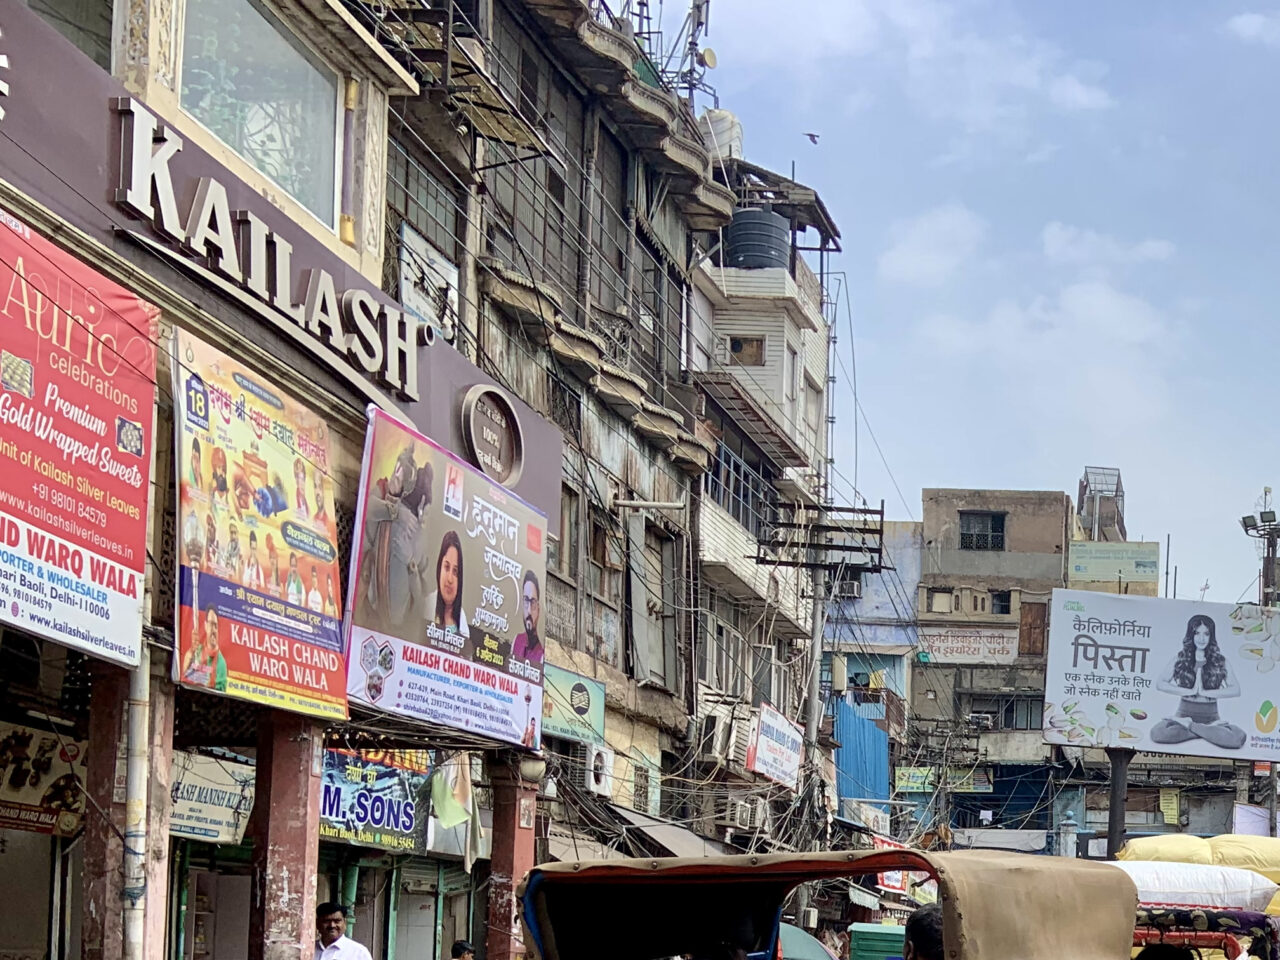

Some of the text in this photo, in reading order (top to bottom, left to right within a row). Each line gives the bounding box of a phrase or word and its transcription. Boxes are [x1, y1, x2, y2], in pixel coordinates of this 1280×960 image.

[115, 97, 420, 402] KAILASH
[1, 256, 122, 377] Auric
[49, 351, 139, 414] celebrations
[188, 389, 206, 417] 18
[44, 381, 108, 437] Premium
[0, 392, 144, 488] Gold Wrapped Sweets
[20, 450, 32, 468] of
[33, 455, 74, 489] Kailash
[76, 476, 105, 503] Silver
[106, 491, 140, 521] Leaves
[32, 482, 107, 528] +91 98101 84579
[0, 490, 134, 561] www.kailashsilverleaves.in
[465, 494, 521, 555] हनुमान
[0, 549, 109, 605] ORTER & WHOLESALER
[26, 527, 138, 600] WARQ WALA
[483, 541, 523, 581] जन्मोत्सव
[13, 587, 53, 612] 9810184579
[19, 573, 47, 598] Baoli,
[50, 586, 111, 621] Delhi-110006
[480, 584, 505, 610] हार्दिक
[28, 611, 136, 659] www.kailashsilverleaves.in
[230, 622, 289, 659] KAILASH
[293, 643, 339, 672] CHAND
[1072, 614, 1152, 639] कैलिफ़ोर्निया
[248, 651, 329, 692] WARQ WALA
[401, 644, 441, 671] KAILASH
[442, 657, 471, 680] CHAND
[473, 666, 497, 690] WARQ
[498, 676, 519, 696] WALA
[1071, 633, 1151, 674] पिस्ता
[407, 666, 452, 686] MANUFACTURER,
[452, 679, 480, 694] EXPORTER
[1064, 672, 1152, 688] एक उनके लिए
[1064, 683, 1142, 701] जो नहीं खाते
[19, 809, 39, 822] WARQ
[39, 812, 57, 825] WALA
[194, 785, 228, 808] MANISH
[321, 783, 415, 832] M. SONS
[357, 831, 374, 843] Delhi
